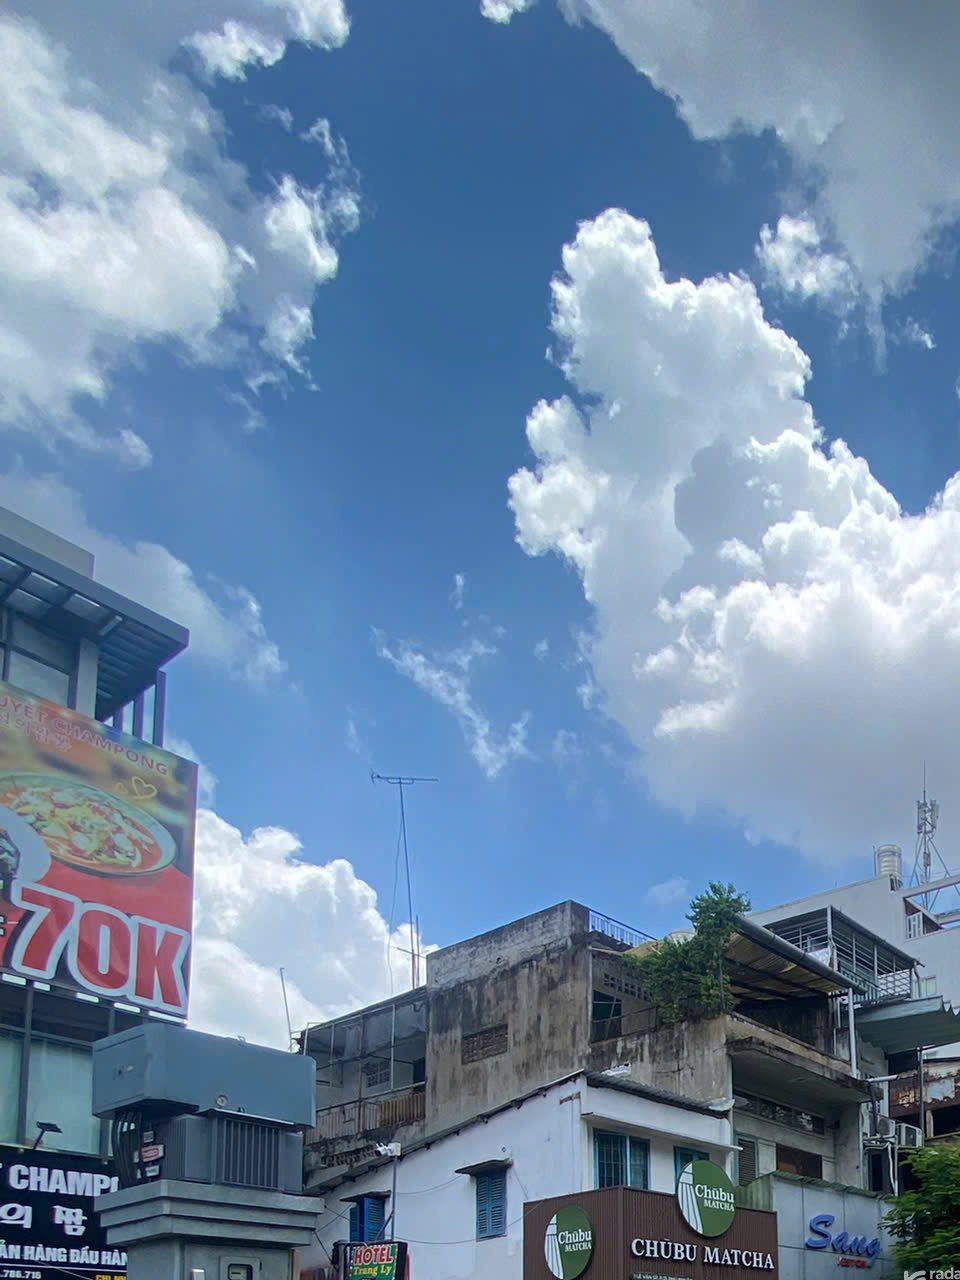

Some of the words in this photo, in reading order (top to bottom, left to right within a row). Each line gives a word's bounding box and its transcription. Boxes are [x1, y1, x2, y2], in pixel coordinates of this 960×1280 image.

[11, 880, 191, 1014] 70K
[703, 1200, 735, 1212] MATCHA
[565, 1241, 592, 1252] MATCHA
[805, 1214, 882, 1265] Sang
[354, 1246, 393, 1265] HOTEL
[704, 1246, 775, 1269] MATCHA
[353, 1266, 377, 1276] Trang
[381, 1265, 392, 1275] Ly
